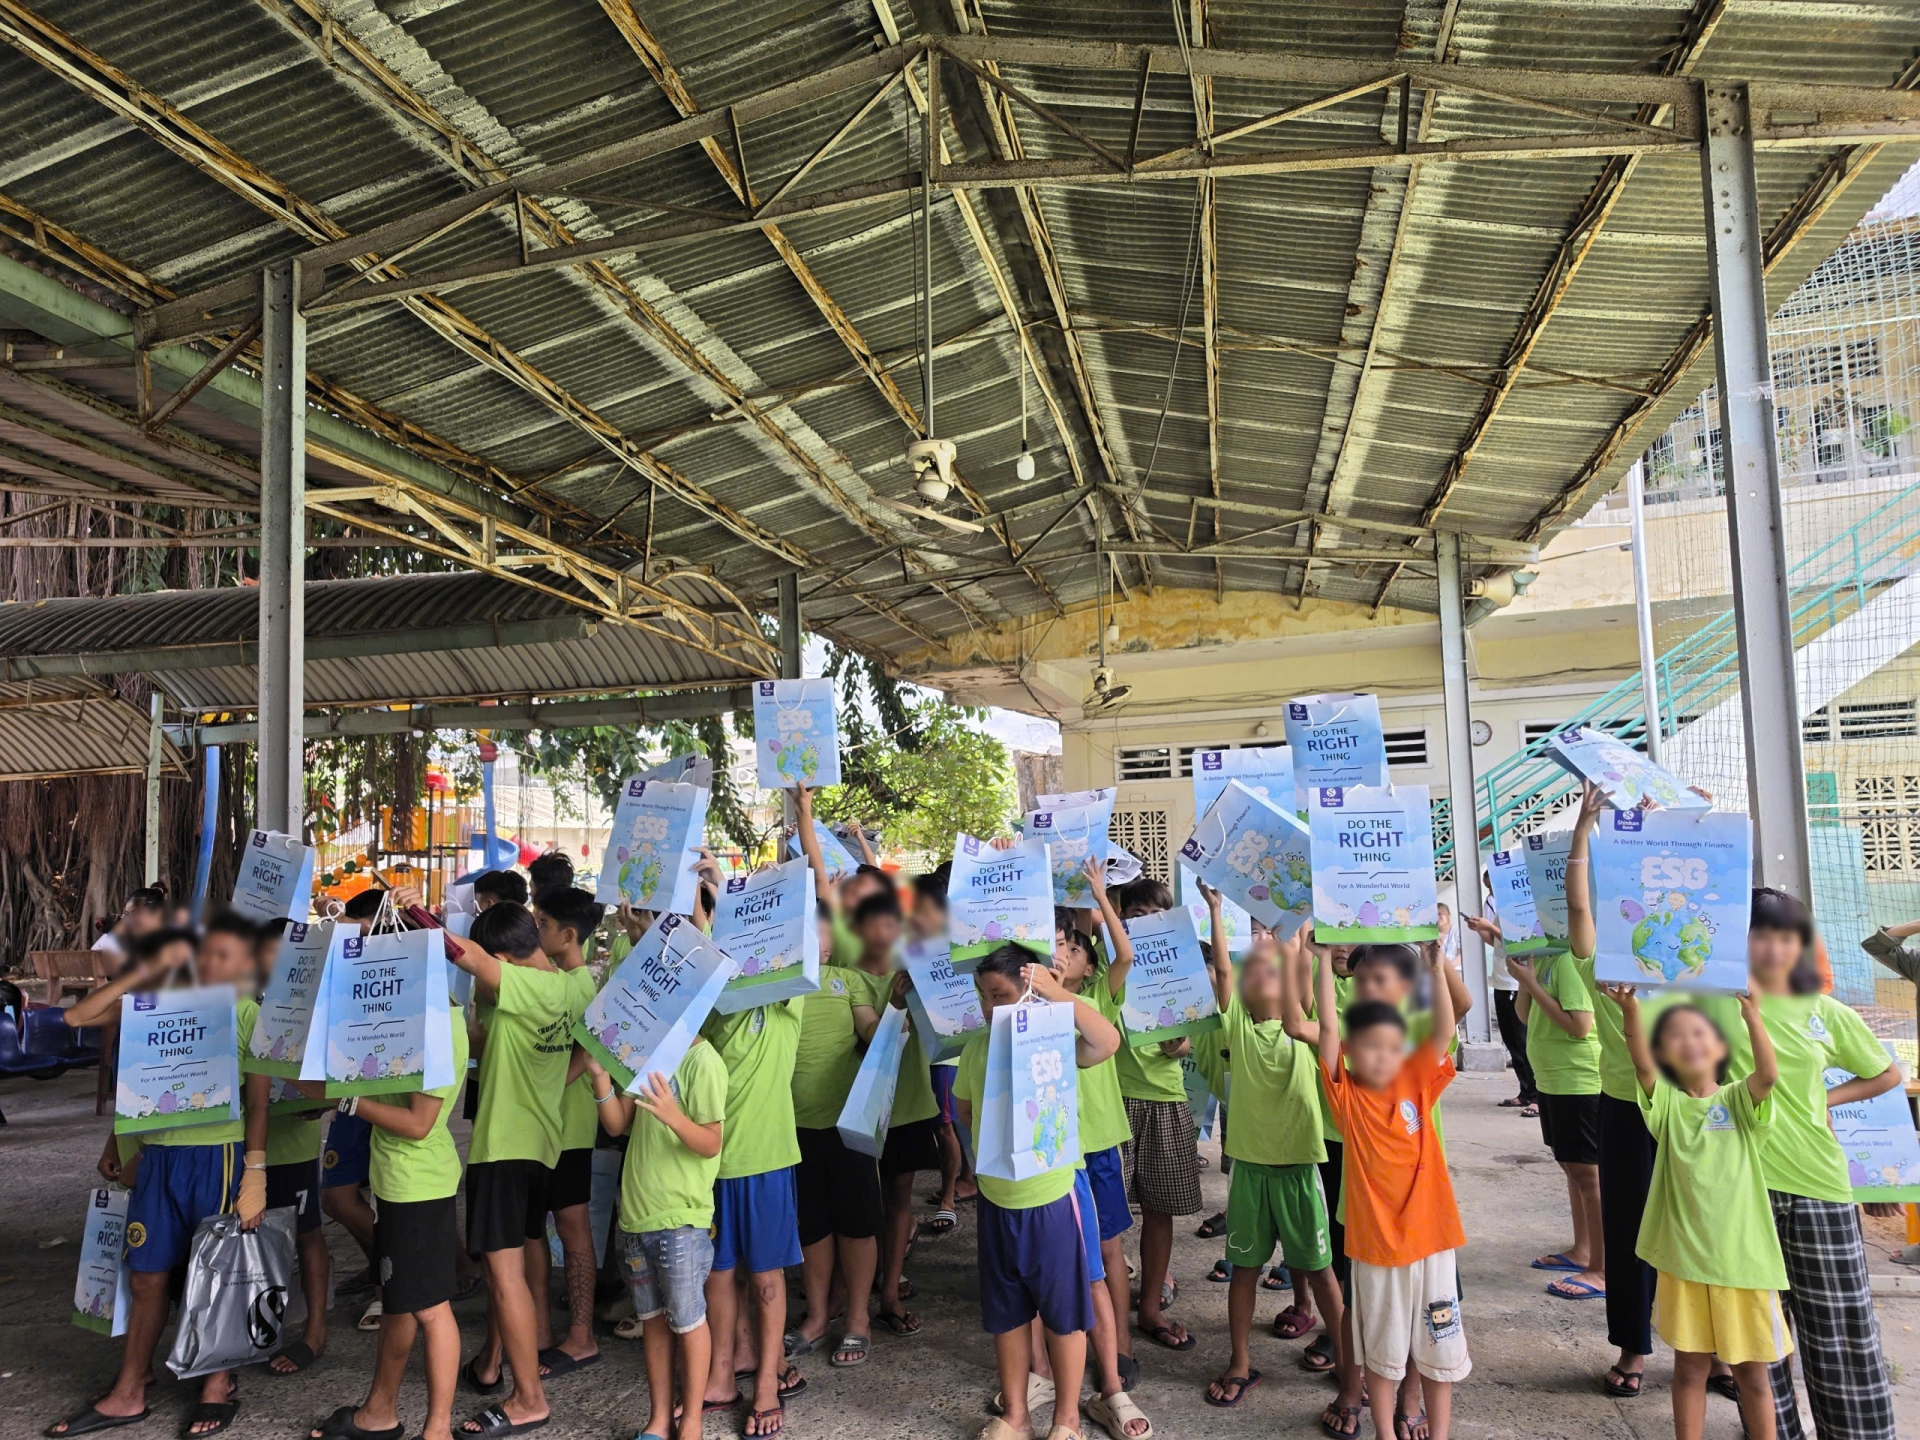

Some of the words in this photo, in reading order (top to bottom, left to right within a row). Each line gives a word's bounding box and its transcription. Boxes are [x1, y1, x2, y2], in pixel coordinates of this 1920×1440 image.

[777, 710, 813, 731] ESG
[1331, 727, 1349, 735] THE
[1307, 736, 1359, 751] RIGHT
[1321, 752, 1350, 761] THING
[1236, 805, 1251, 822] Finance
[633, 816, 669, 840] ESG
[1348, 820, 1366, 829] DO
[1370, 820, 1392, 828] THE
[1339, 832, 1403, 848] RIGHT
[1671, 841, 1702, 849] Through
[1226, 830, 1269, 873] ESG
[1353, 853, 1391, 862] THING
[260, 859, 269, 867] DO
[270, 862, 282, 872] THE
[998, 863, 1015, 871] THE
[252, 866, 284, 886] RIGHT
[972, 870, 1024, 887] RIGHT
[1545, 868, 1566, 881] RIG
[1641, 856, 1708, 890] ESG
[256, 883, 274, 895] THING
[982, 885, 1013, 895] THING
[744, 895, 758, 904] DO
[760, 888, 777, 899] THE
[735, 894, 784, 918] RIGHT
[743, 913, 772, 927] THING
[1136, 943, 1149, 951] DO
[1151, 939, 1169, 948] THE
[298, 956, 308, 965] DO
[1133, 946, 1178, 967] RIGHT
[932, 960, 944, 968] DO
[287, 968, 317, 984] RIGHT
[362, 970, 376, 979] DO
[379, 967, 396, 978] THE
[641, 957, 681, 995] RIGHT
[930, 967, 956, 982] RIG
[1145, 966, 1173, 977] THING
[353, 979, 404, 1000] RIGHT
[944, 978, 969, 989] THING
[638, 979, 660, 1002] THING
[362, 1002, 392, 1014] THING
[158, 1020, 174, 1029] DO
[179, 1017, 198, 1027] THE
[147, 1027, 207, 1046] RIGHT
[362, 1033, 388, 1041] Wonderful
[159, 1046, 193, 1058] THING
[1031, 1050, 1062, 1085] ESG
[158, 1073, 188, 1081] Wonderful
[1829, 1110, 1867, 1119] THING
[296, 1189, 308, 1215] 7
[105, 1221, 113, 1230] DO
[1317, 1228, 1327, 1255] 5
